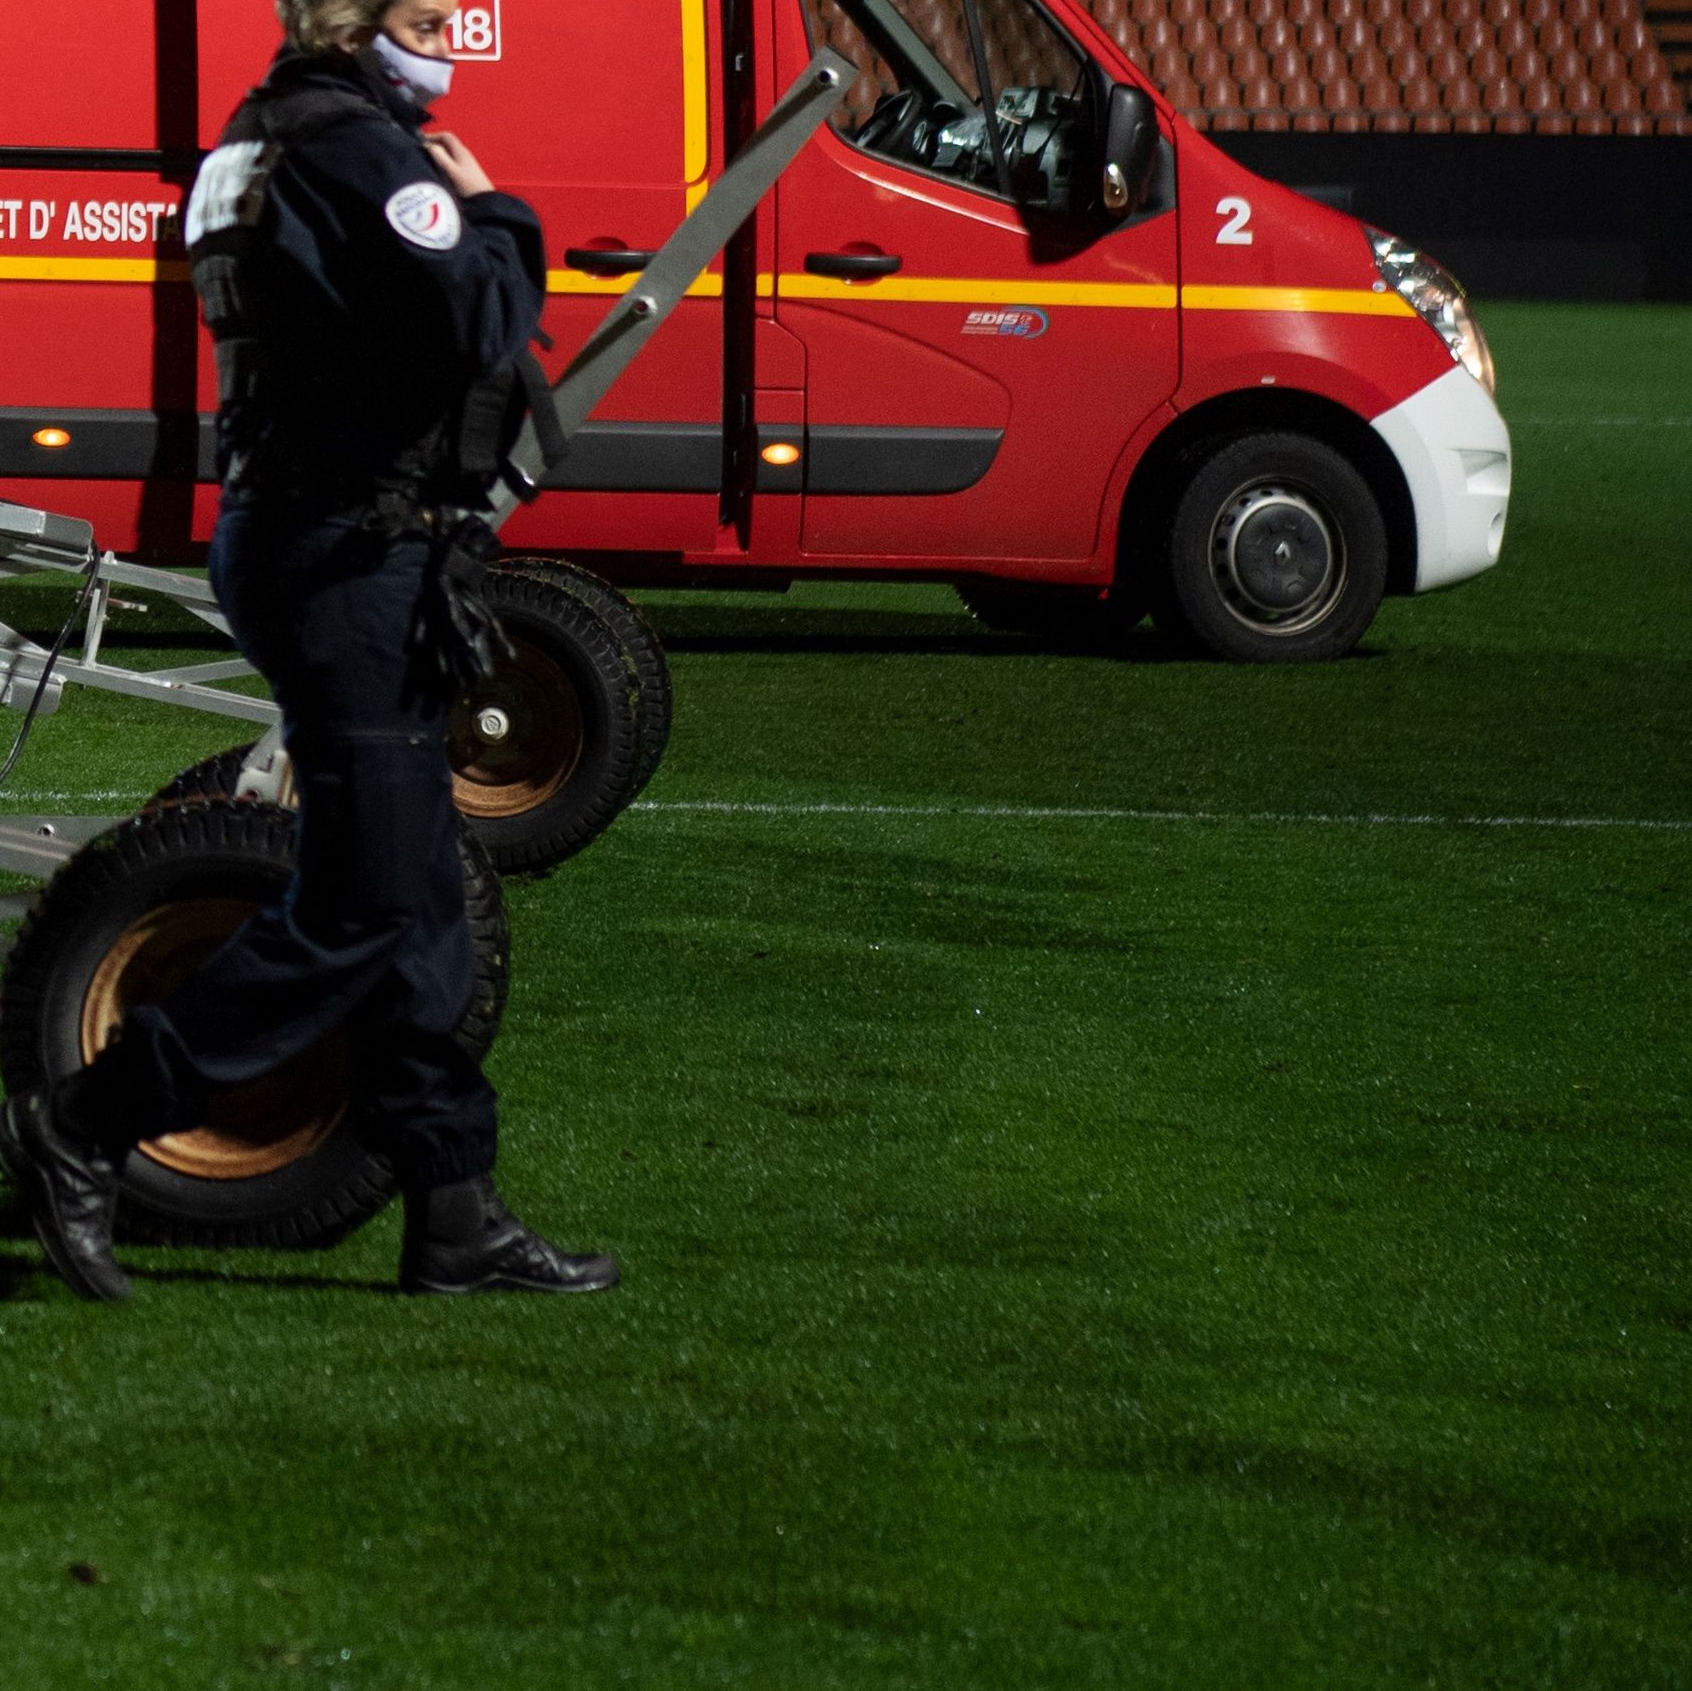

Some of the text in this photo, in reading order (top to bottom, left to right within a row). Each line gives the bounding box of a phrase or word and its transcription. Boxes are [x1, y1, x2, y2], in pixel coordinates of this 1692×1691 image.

[447, 10, 494, 51] 18
[28, 198, 57, 241] D'
[1214, 196, 1254, 246] 2
[965, 311, 1022, 325] SDIS
